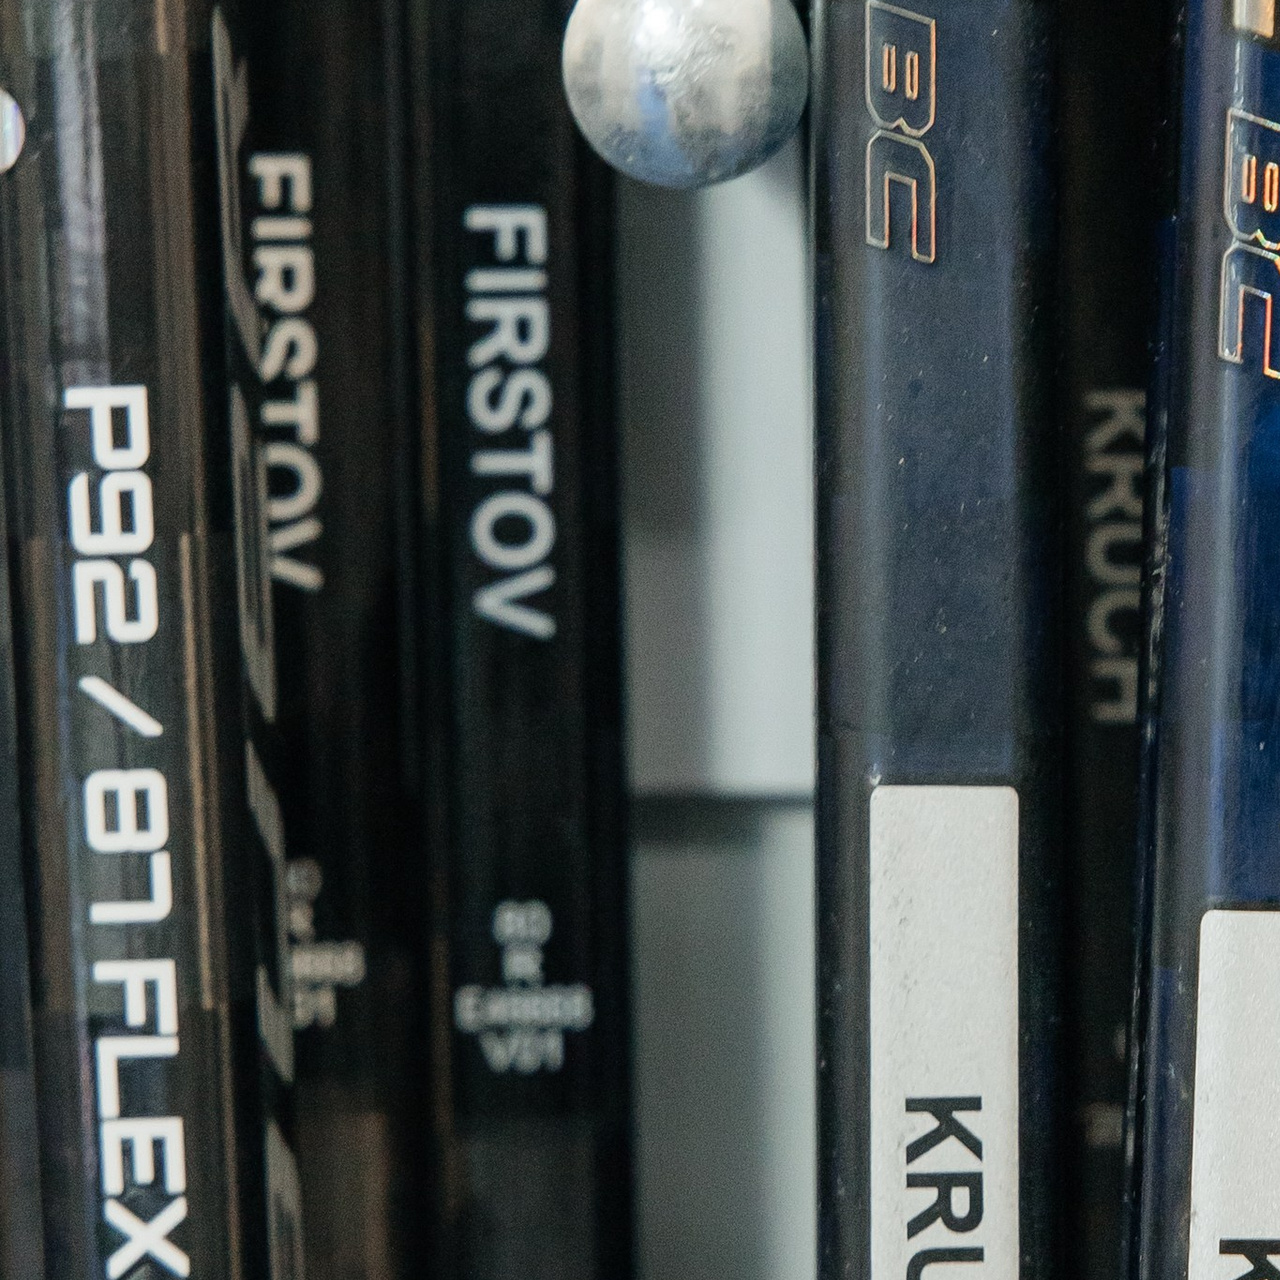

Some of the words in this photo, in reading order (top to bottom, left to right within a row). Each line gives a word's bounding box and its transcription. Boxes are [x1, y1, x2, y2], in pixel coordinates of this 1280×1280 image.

[64, 384, 159, 644] P92
[462, 203, 557, 641] FIRSTOV
[79, 675, 164, 737] /
[84, 767, 173, 924] 87
